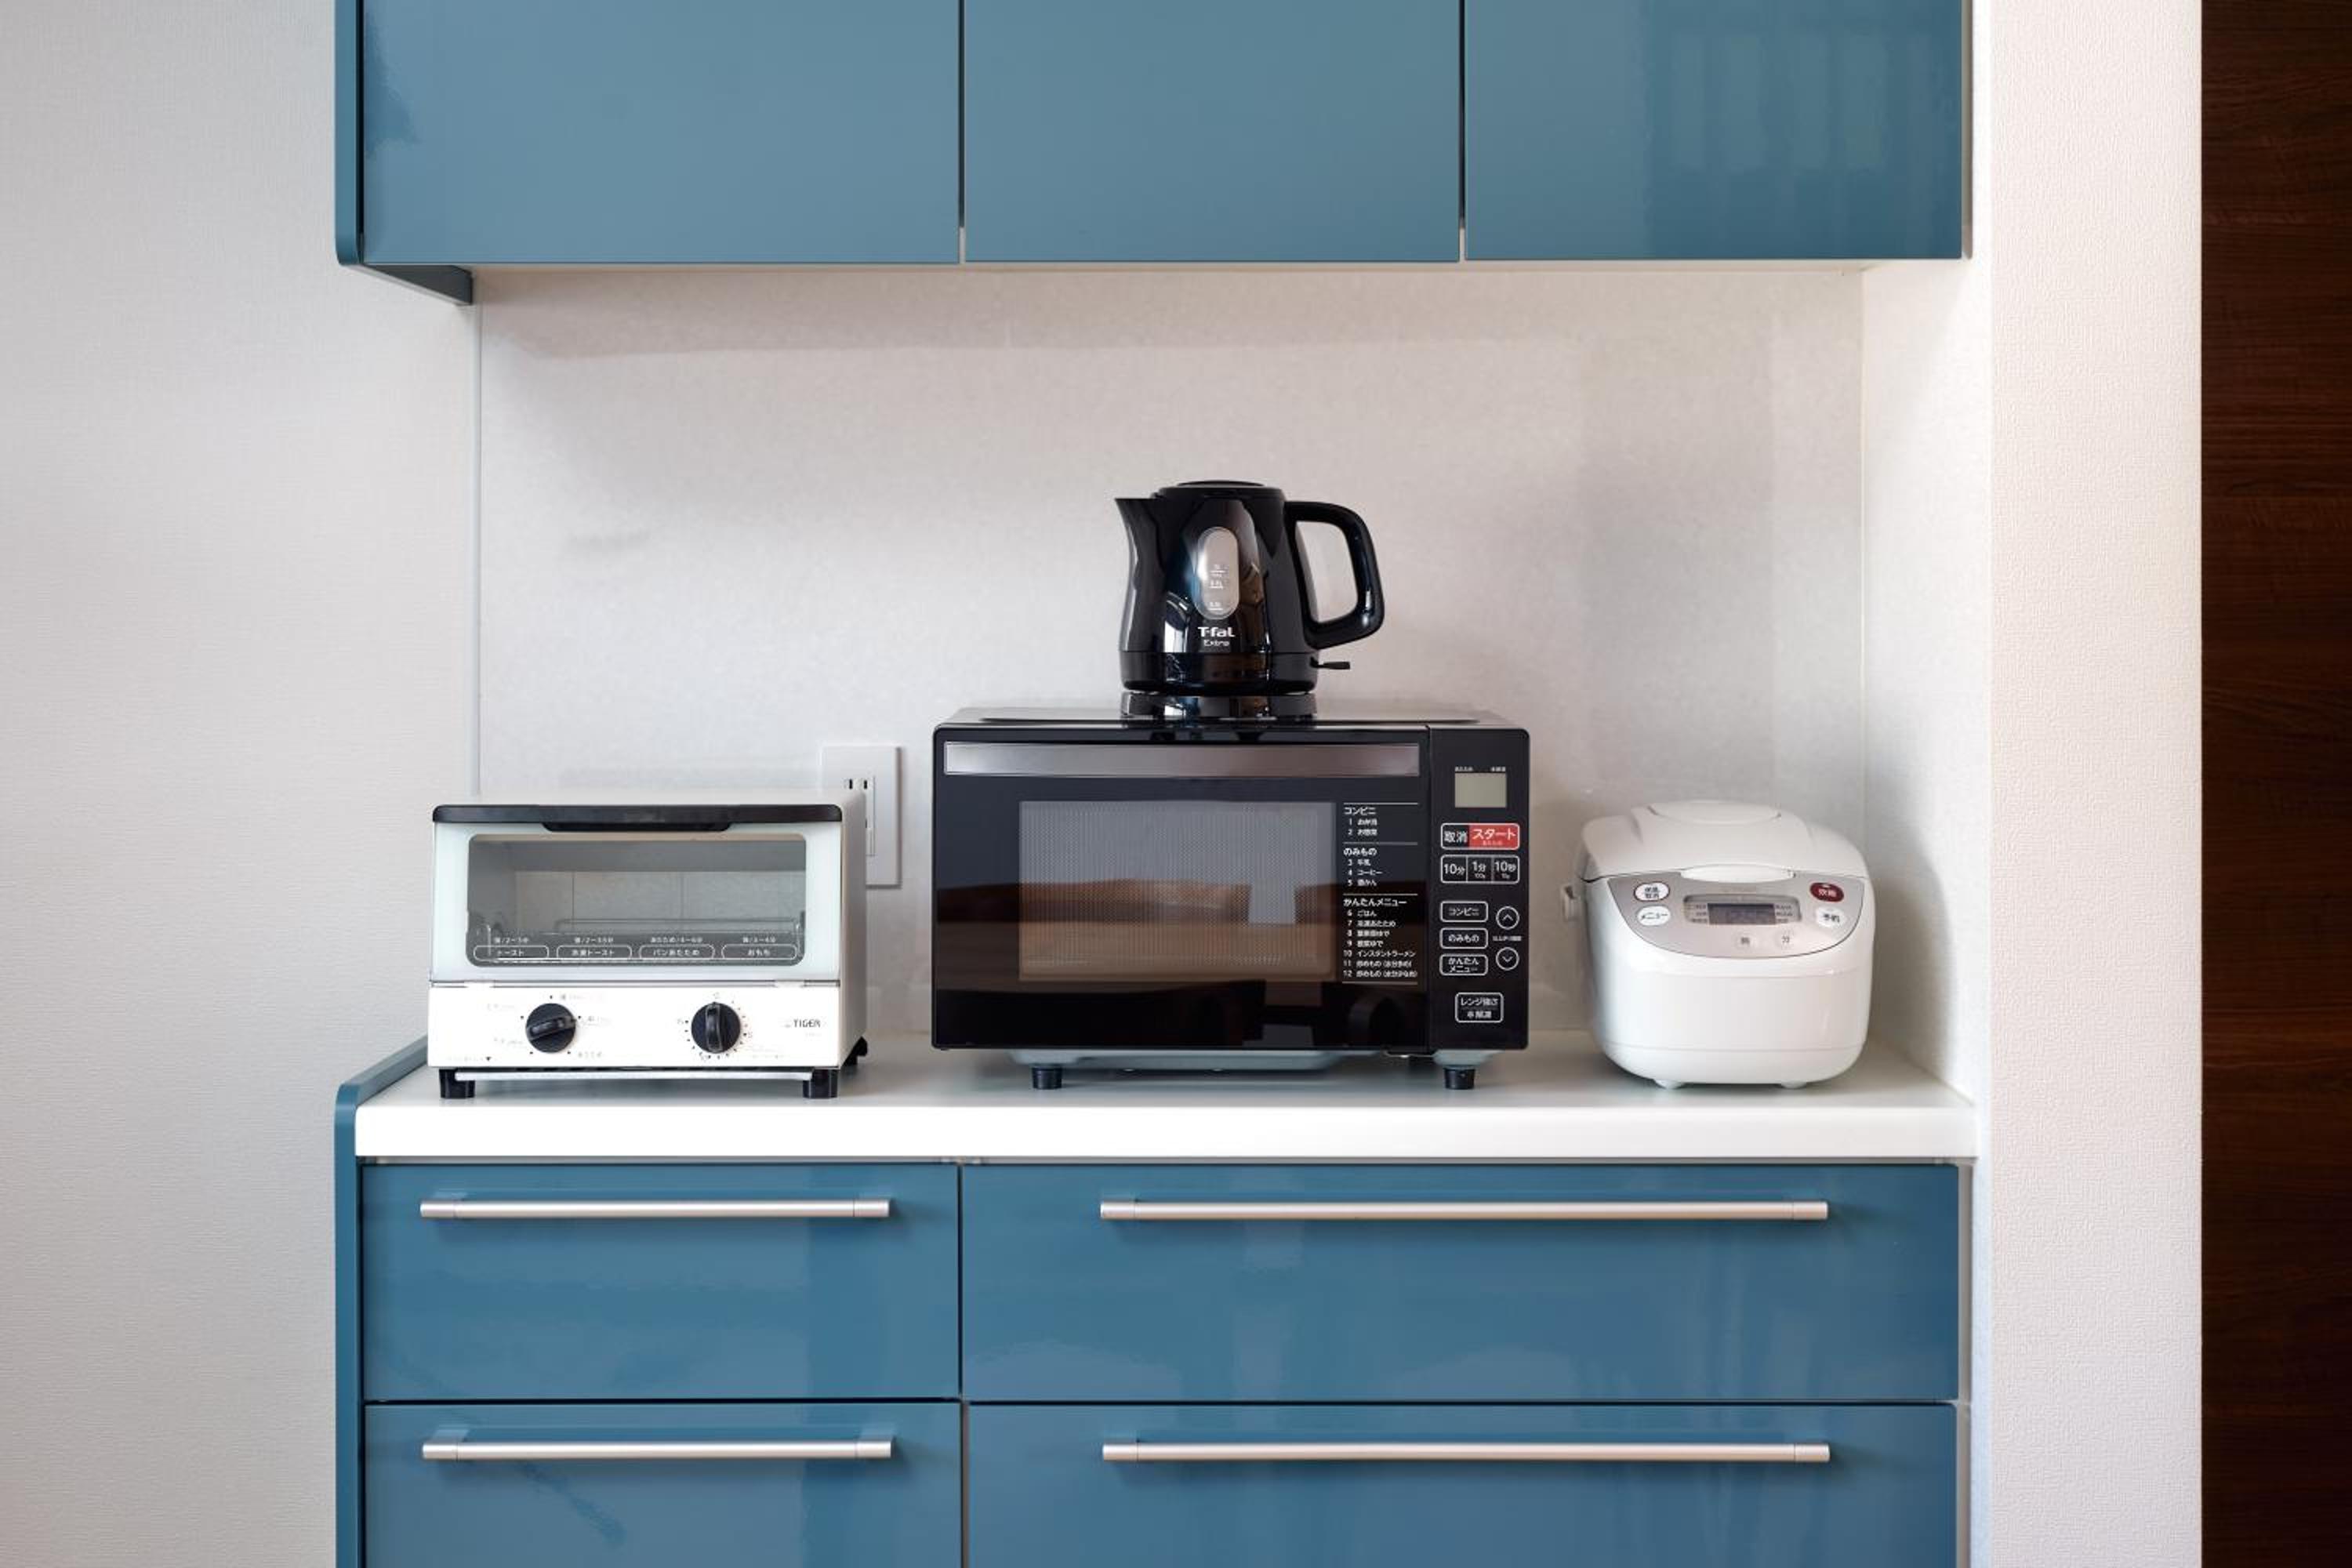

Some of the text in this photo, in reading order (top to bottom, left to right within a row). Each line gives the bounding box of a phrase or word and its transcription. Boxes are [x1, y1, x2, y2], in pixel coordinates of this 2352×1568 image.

[1344, 807, 1377, 815] コンビニ
[1443, 830, 1468, 844] 取消
[1472, 829, 1516, 840] スタート
[1343, 848, 1377, 856] のみもの
[1443, 863, 1465, 875] 10分
[1472, 861, 1486, 873] 1分
[1343, 898, 1407, 906] かんたんメニュー
[1449, 907, 1479, 916] コンビニ
[1448, 934, 1479, 943] のみもの
[1448, 957, 1479, 966] かんたん
[793, 1019, 821, 1028] TIGER
